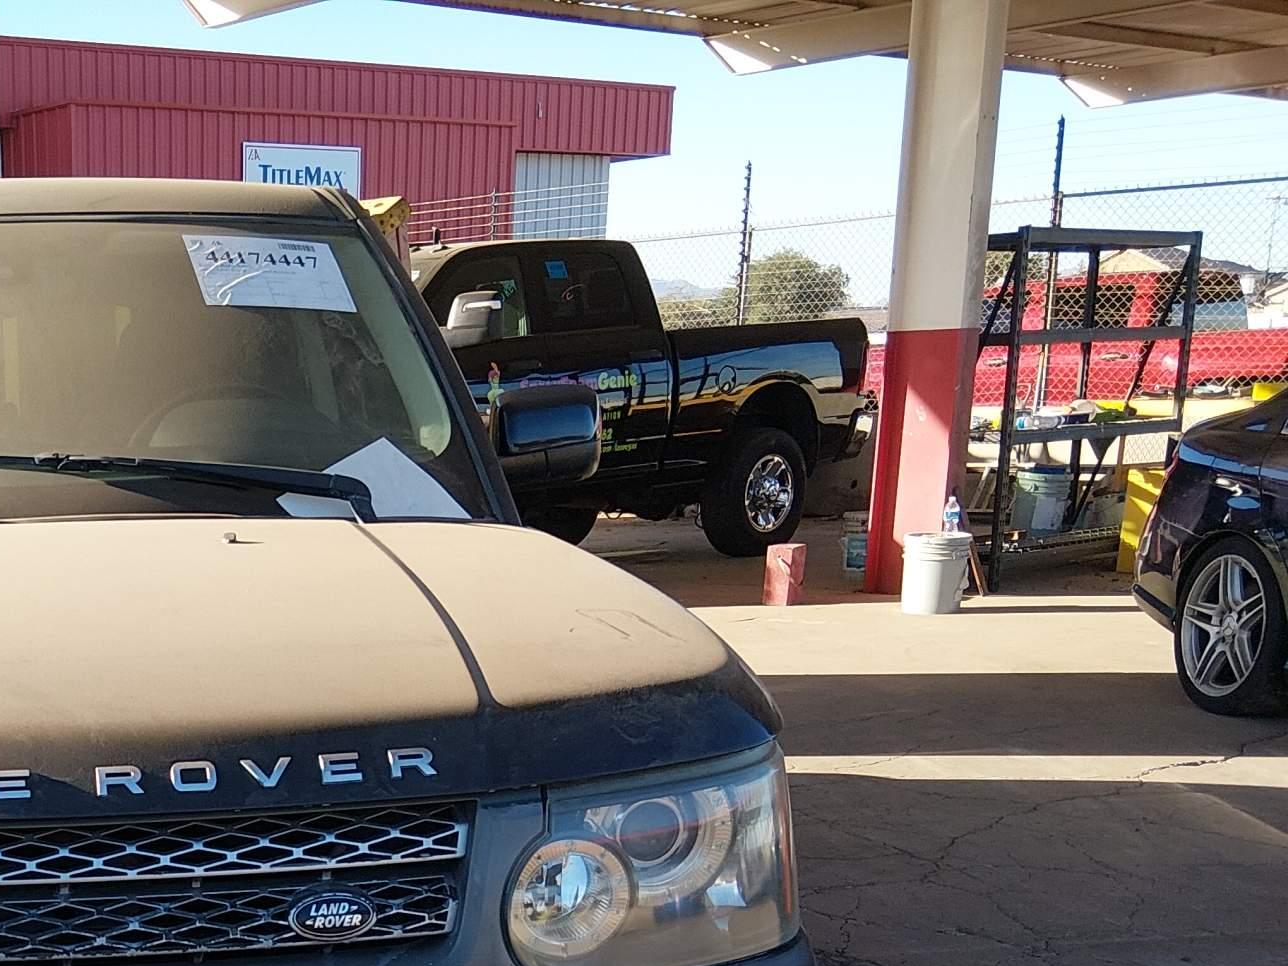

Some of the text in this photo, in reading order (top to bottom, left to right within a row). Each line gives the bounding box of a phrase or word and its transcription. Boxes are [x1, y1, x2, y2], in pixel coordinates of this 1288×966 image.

[206, 250, 317, 269] 44174447
[602, 411, 622, 421] ATION
[95, 747, 438, 797] ROVER
[310, 902, 350, 916] LAND
[313, 913, 363, 929] ROVER
